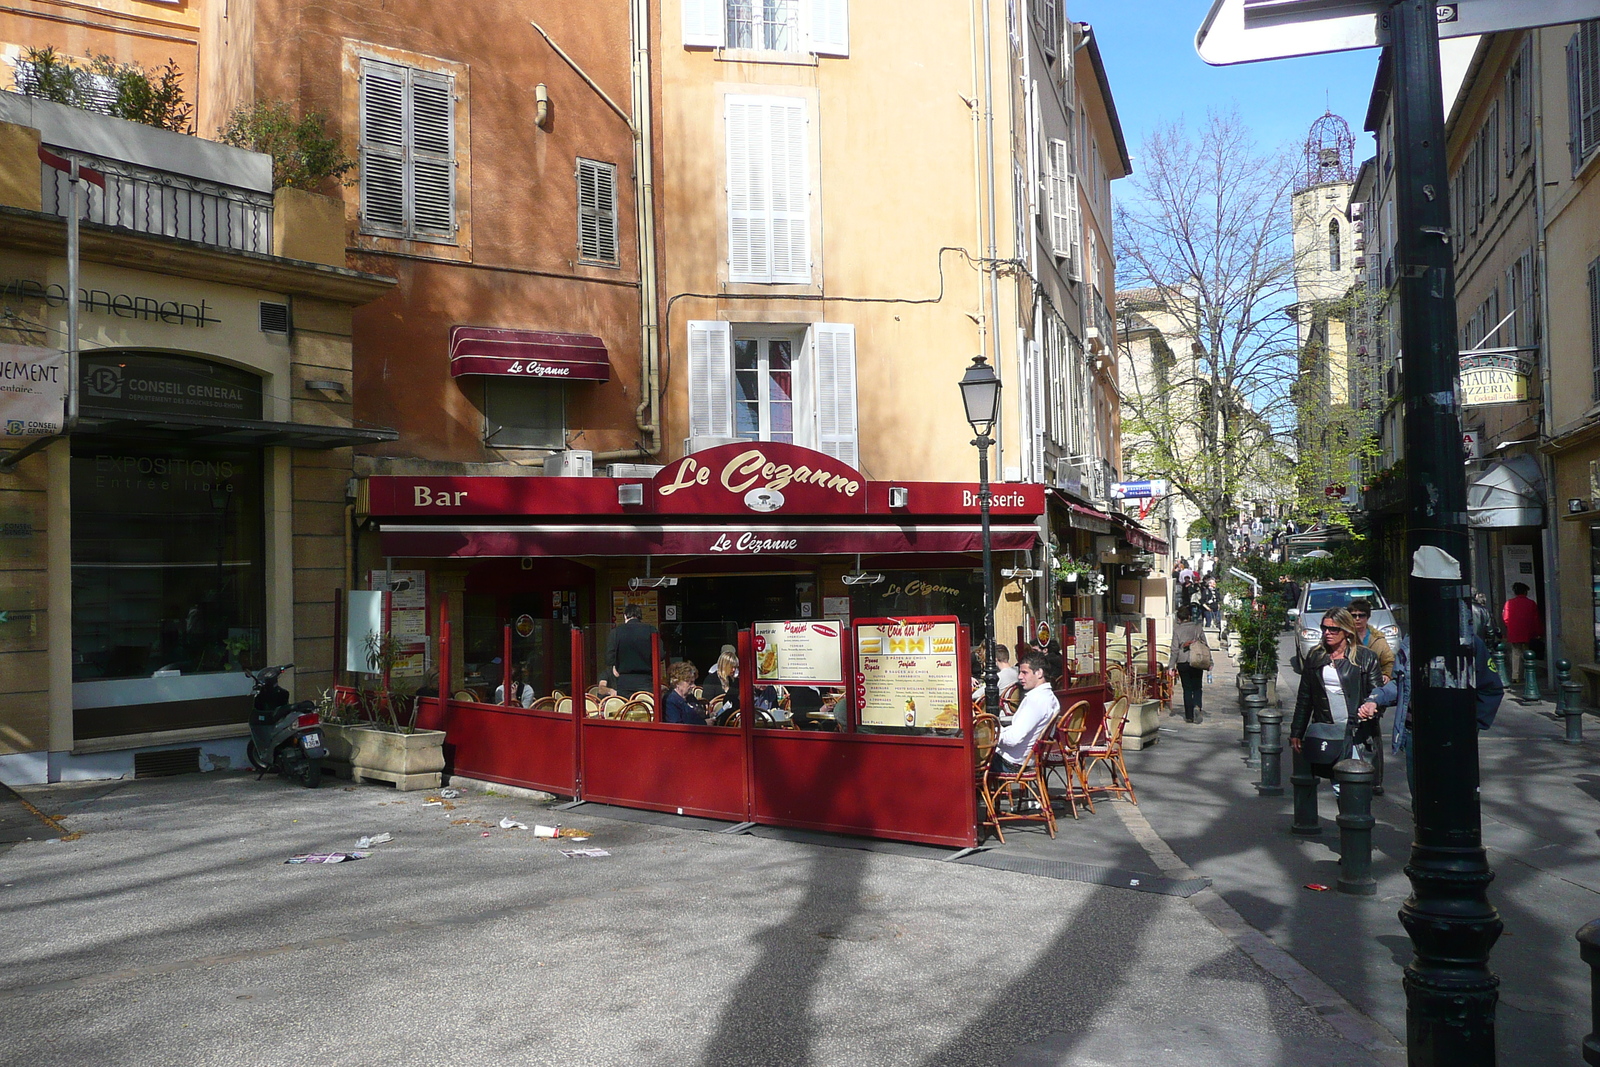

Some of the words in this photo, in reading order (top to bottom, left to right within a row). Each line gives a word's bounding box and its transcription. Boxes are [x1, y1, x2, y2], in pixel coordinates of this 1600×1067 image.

[507, 360, 523, 374] Le
[526, 361, 570, 377] Cézanne
[129, 379, 184, 395] CONSEIL
[187, 384, 244, 401] GENERAL
[1474, 394, 1498, 403] Cocktail
[1503, 392, 1525, 400] Glacier
[28, 421, 57, 430] CONSEIL
[95, 454, 233, 478] EXPOSITIONS
[658, 457, 711, 496] Le
[720, 449, 860, 497] Cezanne
[96, 475, 170, 491] Entrée
[185, 479, 234, 493] libre
[413, 485, 468, 507] Bar
[962, 489, 1025, 507] Brsserie
[709, 533, 732, 552] Le
[736, 531, 798, 554] Cézanne
[882, 583, 902, 598] Le
[904, 579, 960, 597] Cézanne
[784, 620, 808, 634] Panini
